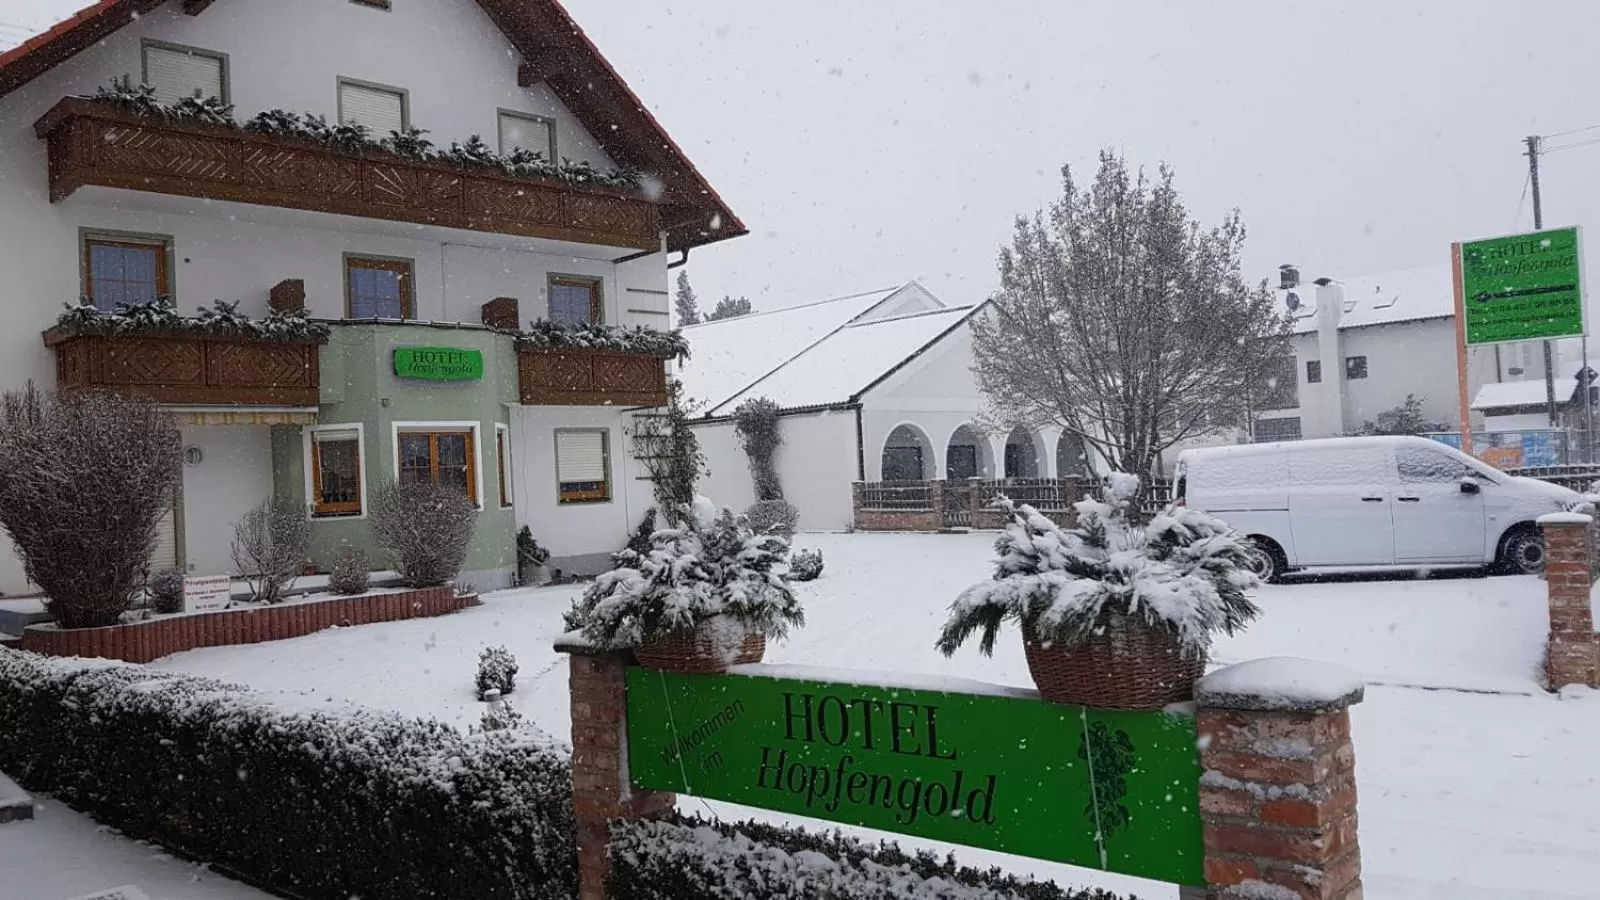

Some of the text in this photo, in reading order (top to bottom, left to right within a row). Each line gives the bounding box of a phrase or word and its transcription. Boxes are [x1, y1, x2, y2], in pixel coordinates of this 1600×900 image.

[412, 350, 468, 364] HOTEL
[781, 691, 958, 761] HOTEL
[702, 751, 724, 773] im
[756, 746, 997, 827] Hopfengold
